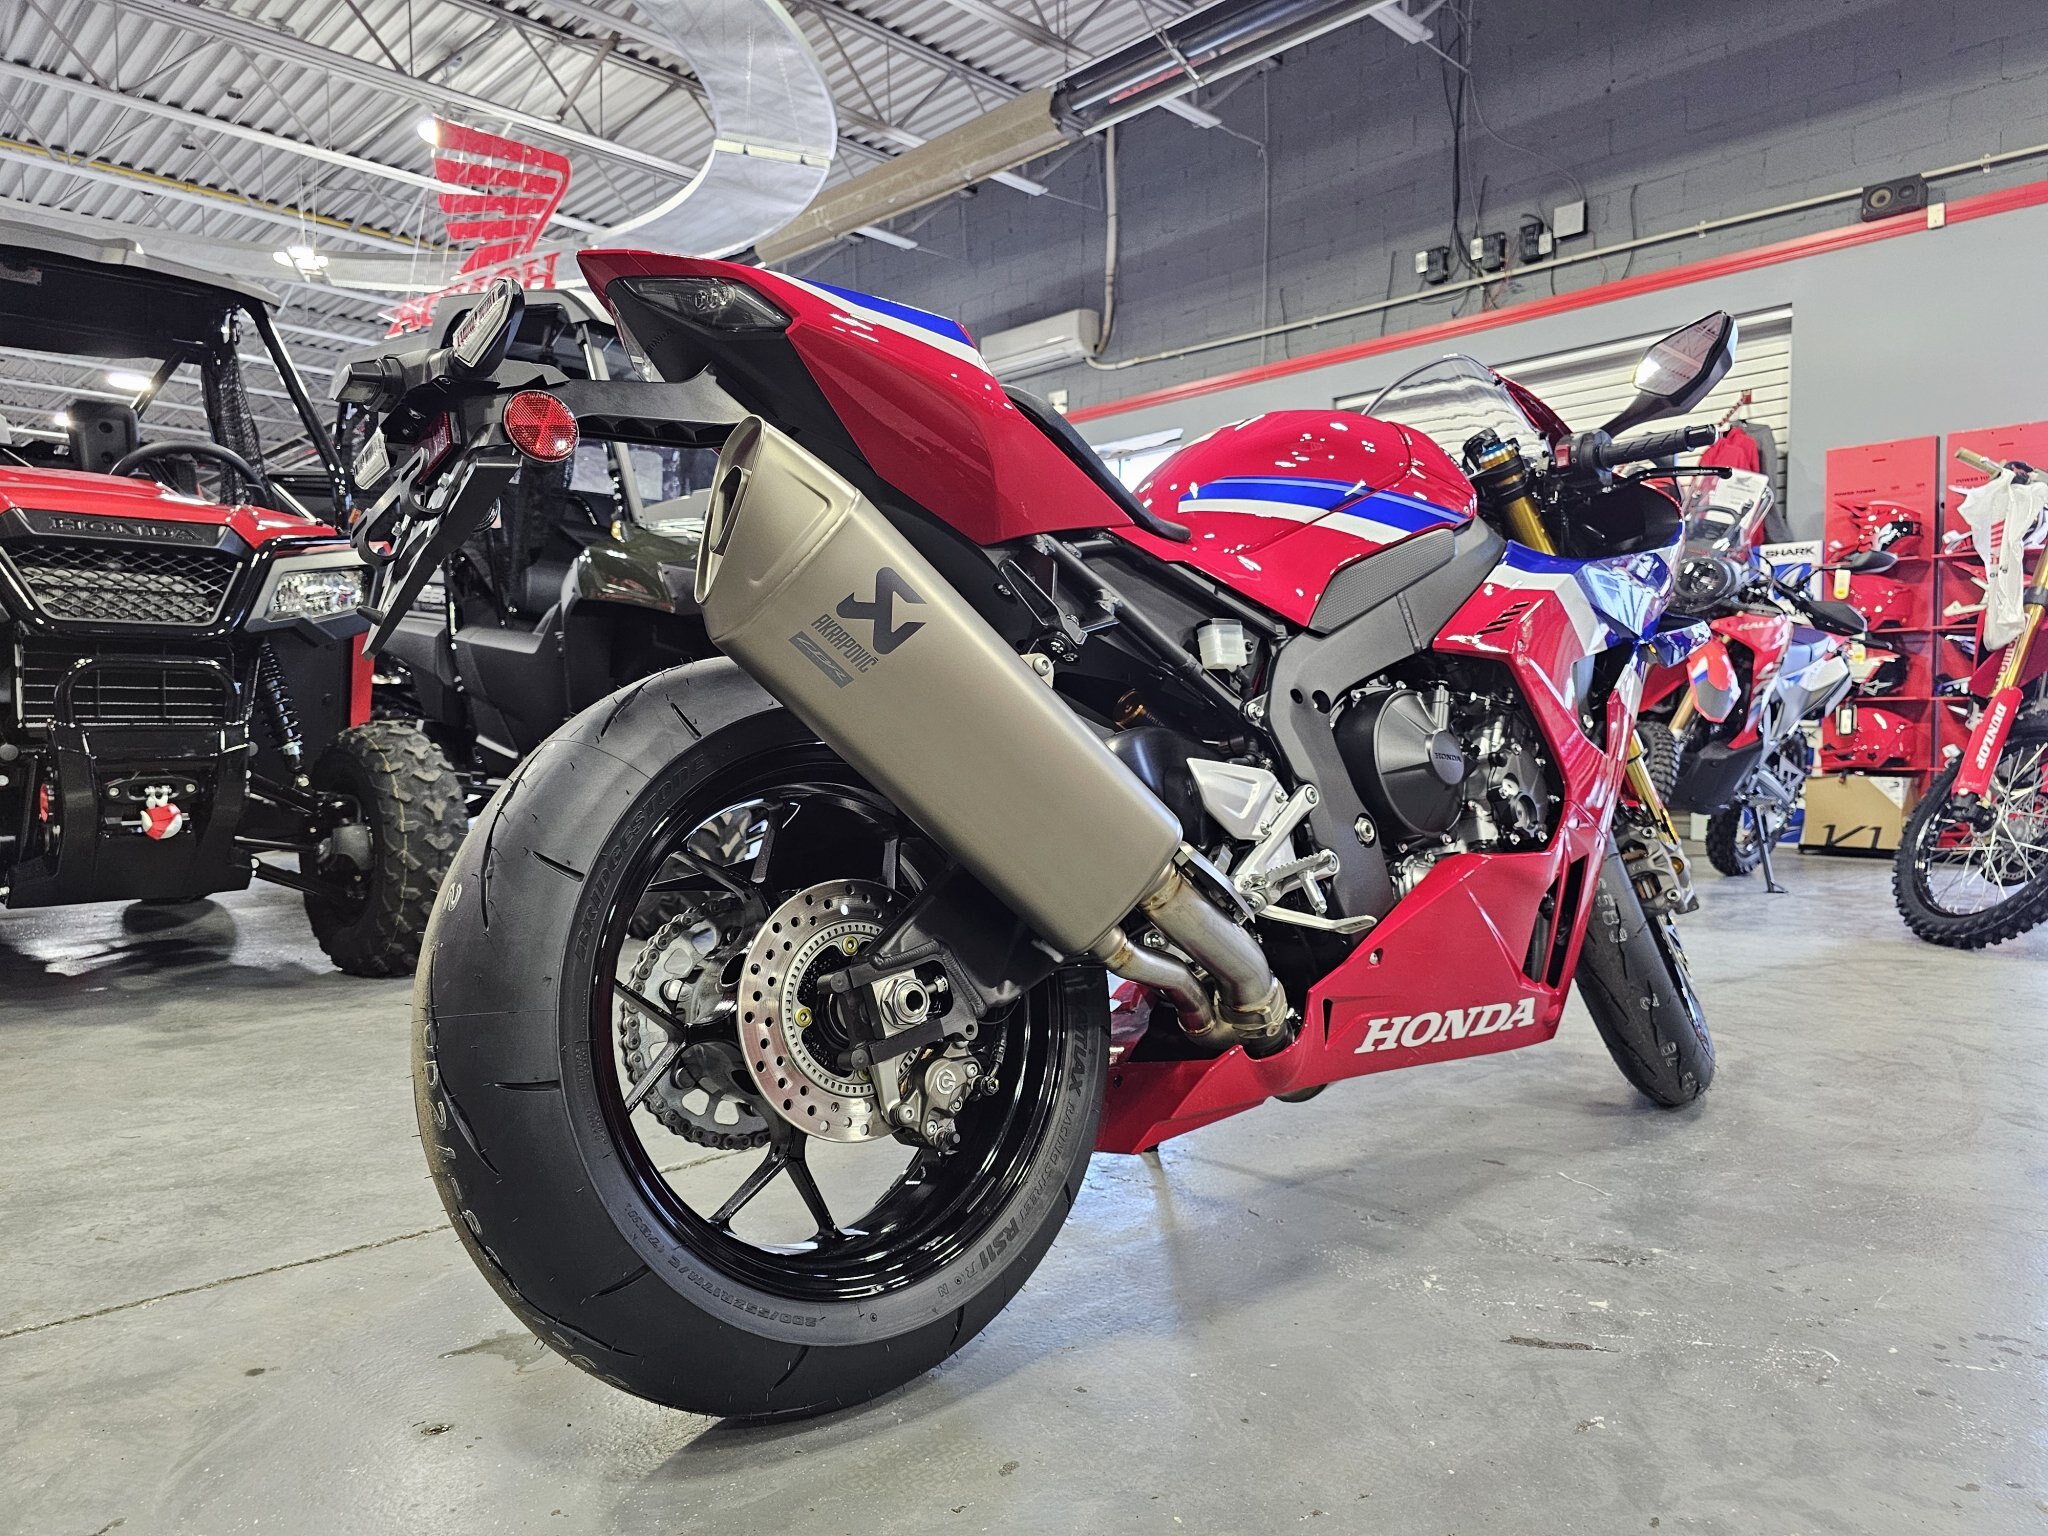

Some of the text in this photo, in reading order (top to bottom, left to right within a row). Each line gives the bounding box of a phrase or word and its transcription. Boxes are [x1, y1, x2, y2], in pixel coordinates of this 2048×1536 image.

[49, 517, 205, 542] HONDA
[1765, 547, 1816, 557] SHARK
[1435, 752, 1462, 762] HONDA
[1975, 701, 2007, 770] DUNLOP
[575, 753, 705, 963] BRIDGESTONE
[1822, 824, 1883, 849] V1
[1354, 997, 1535, 1054] HONDA
[1051, 1099, 1076, 1168] RACING
[1019, 1163, 1054, 1225] STREET
[976, 1216, 1022, 1274] RS11
